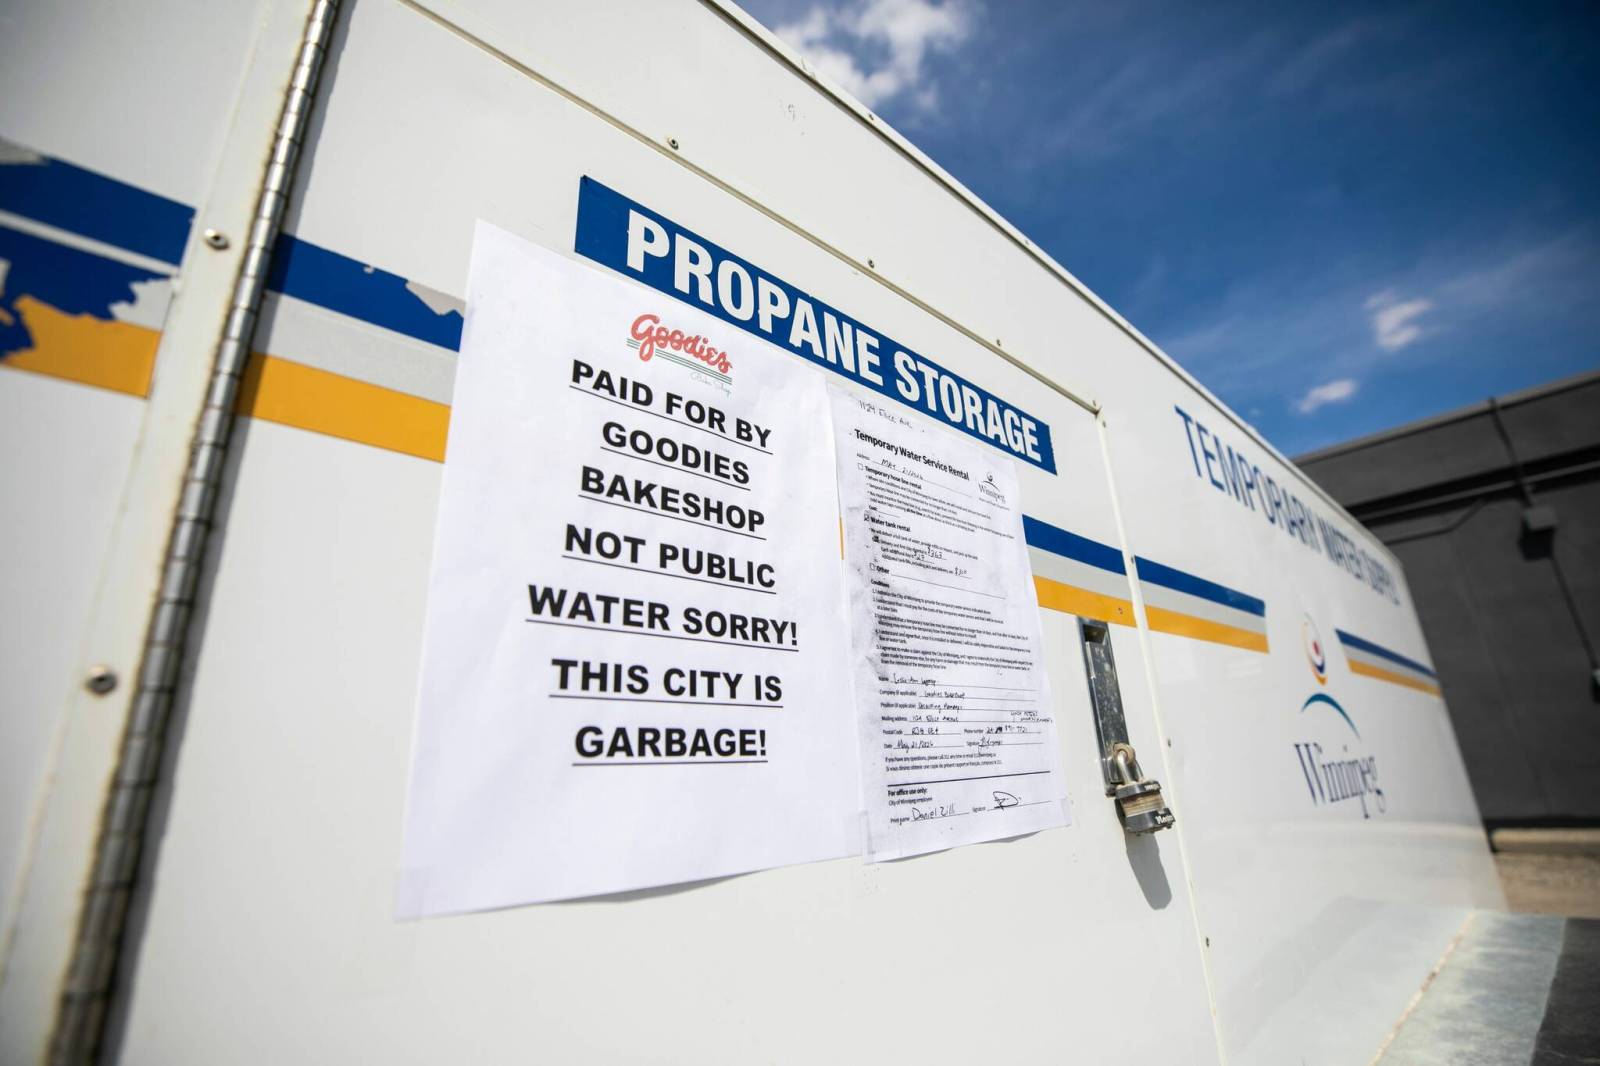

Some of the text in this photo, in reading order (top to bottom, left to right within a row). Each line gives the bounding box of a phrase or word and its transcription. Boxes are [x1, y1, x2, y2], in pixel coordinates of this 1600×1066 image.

[627, 209, 1042, 462] PROPANE STORAGE
[630, 313, 733, 374] Goodies
[571, 359, 772, 449] PAID FOR BY
[602, 421, 750, 485] GOODIES
[854, 428, 970, 481] Temporary Water Service Rental
[581, 465, 765, 532] BAKESHOP
[565, 523, 776, 588] NOT PUBLIC
[528, 584, 798, 646] WATER SORRY!
[551, 658, 783, 702] THIS CITY IS
[575, 725, 766, 758] GARBAGE!
